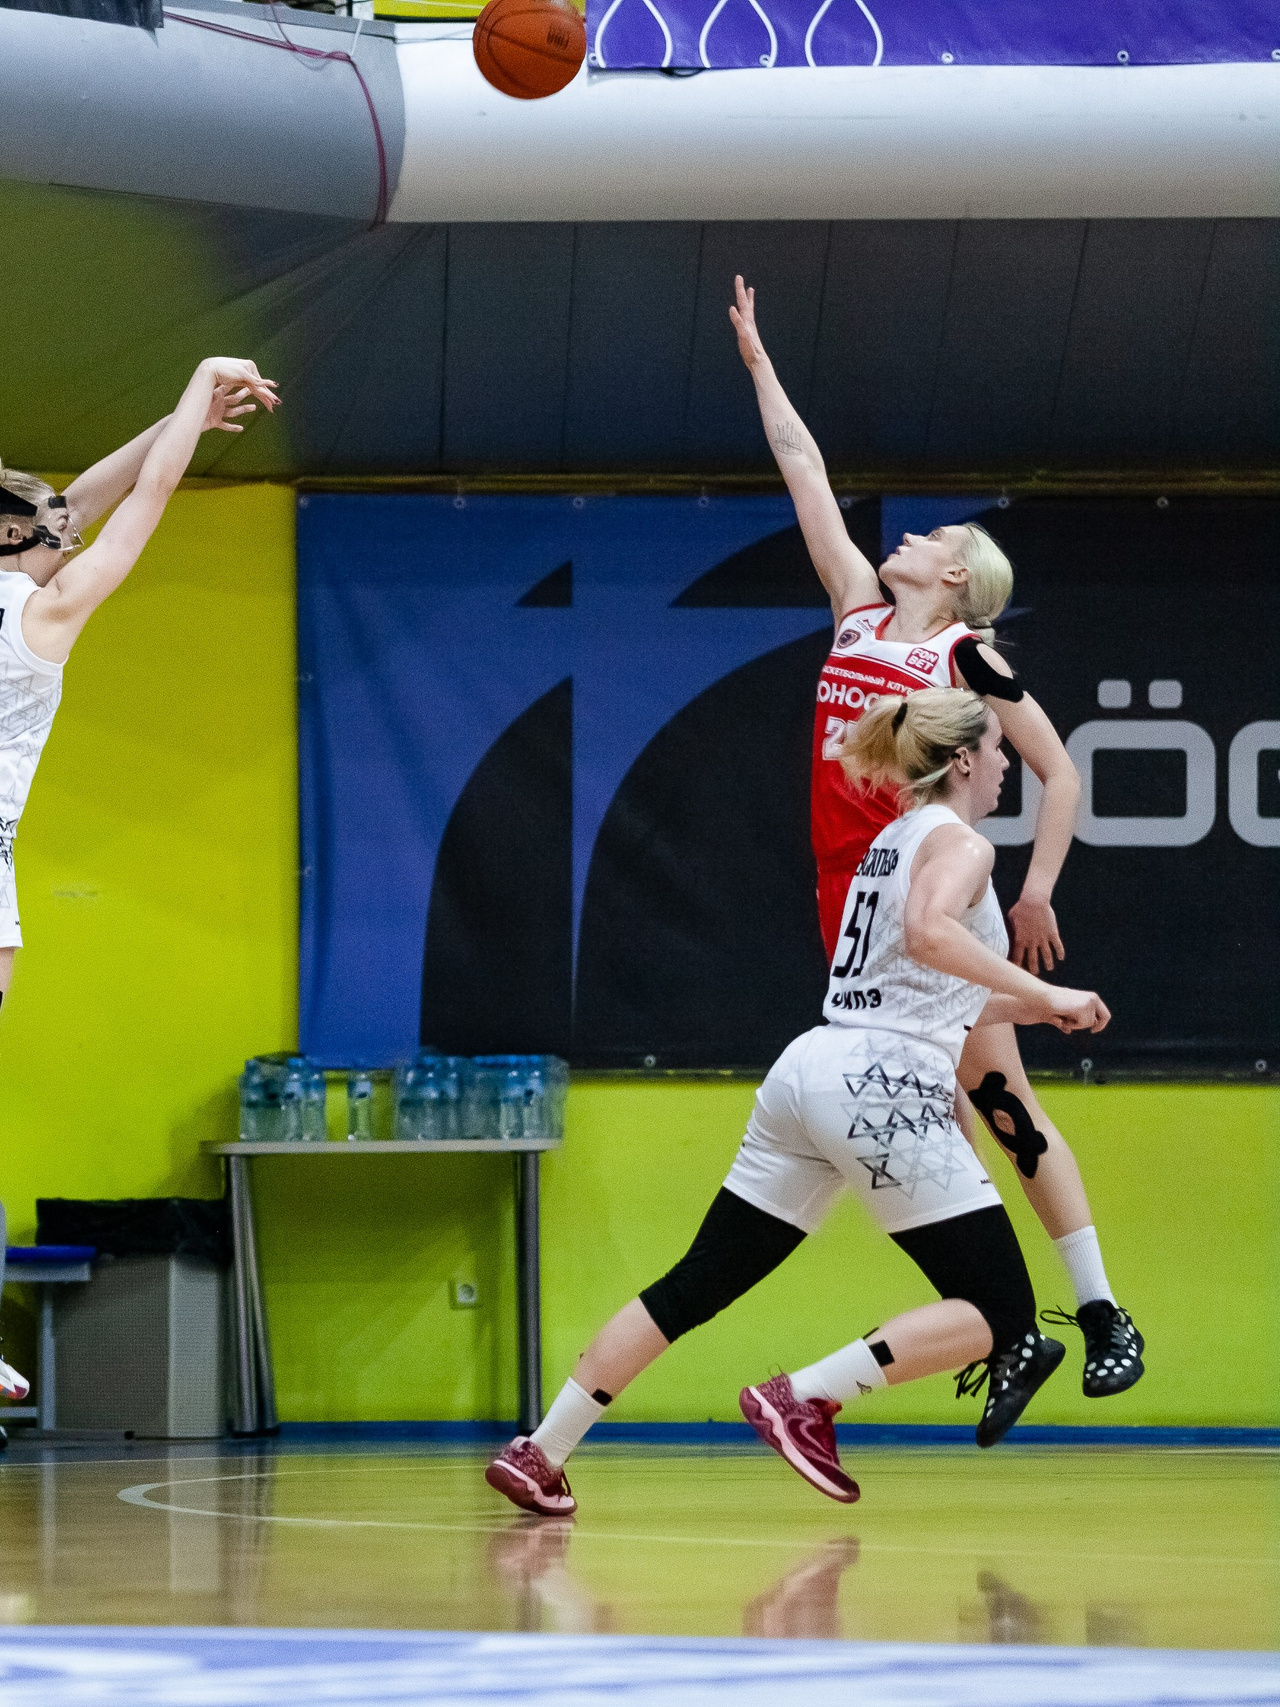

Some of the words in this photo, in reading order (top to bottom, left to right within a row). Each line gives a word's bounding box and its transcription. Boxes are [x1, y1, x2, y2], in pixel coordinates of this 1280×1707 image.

[906, 655, 934, 671] BET
[911, 649, 939, 663] FON
[831, 891, 880, 978] 51
